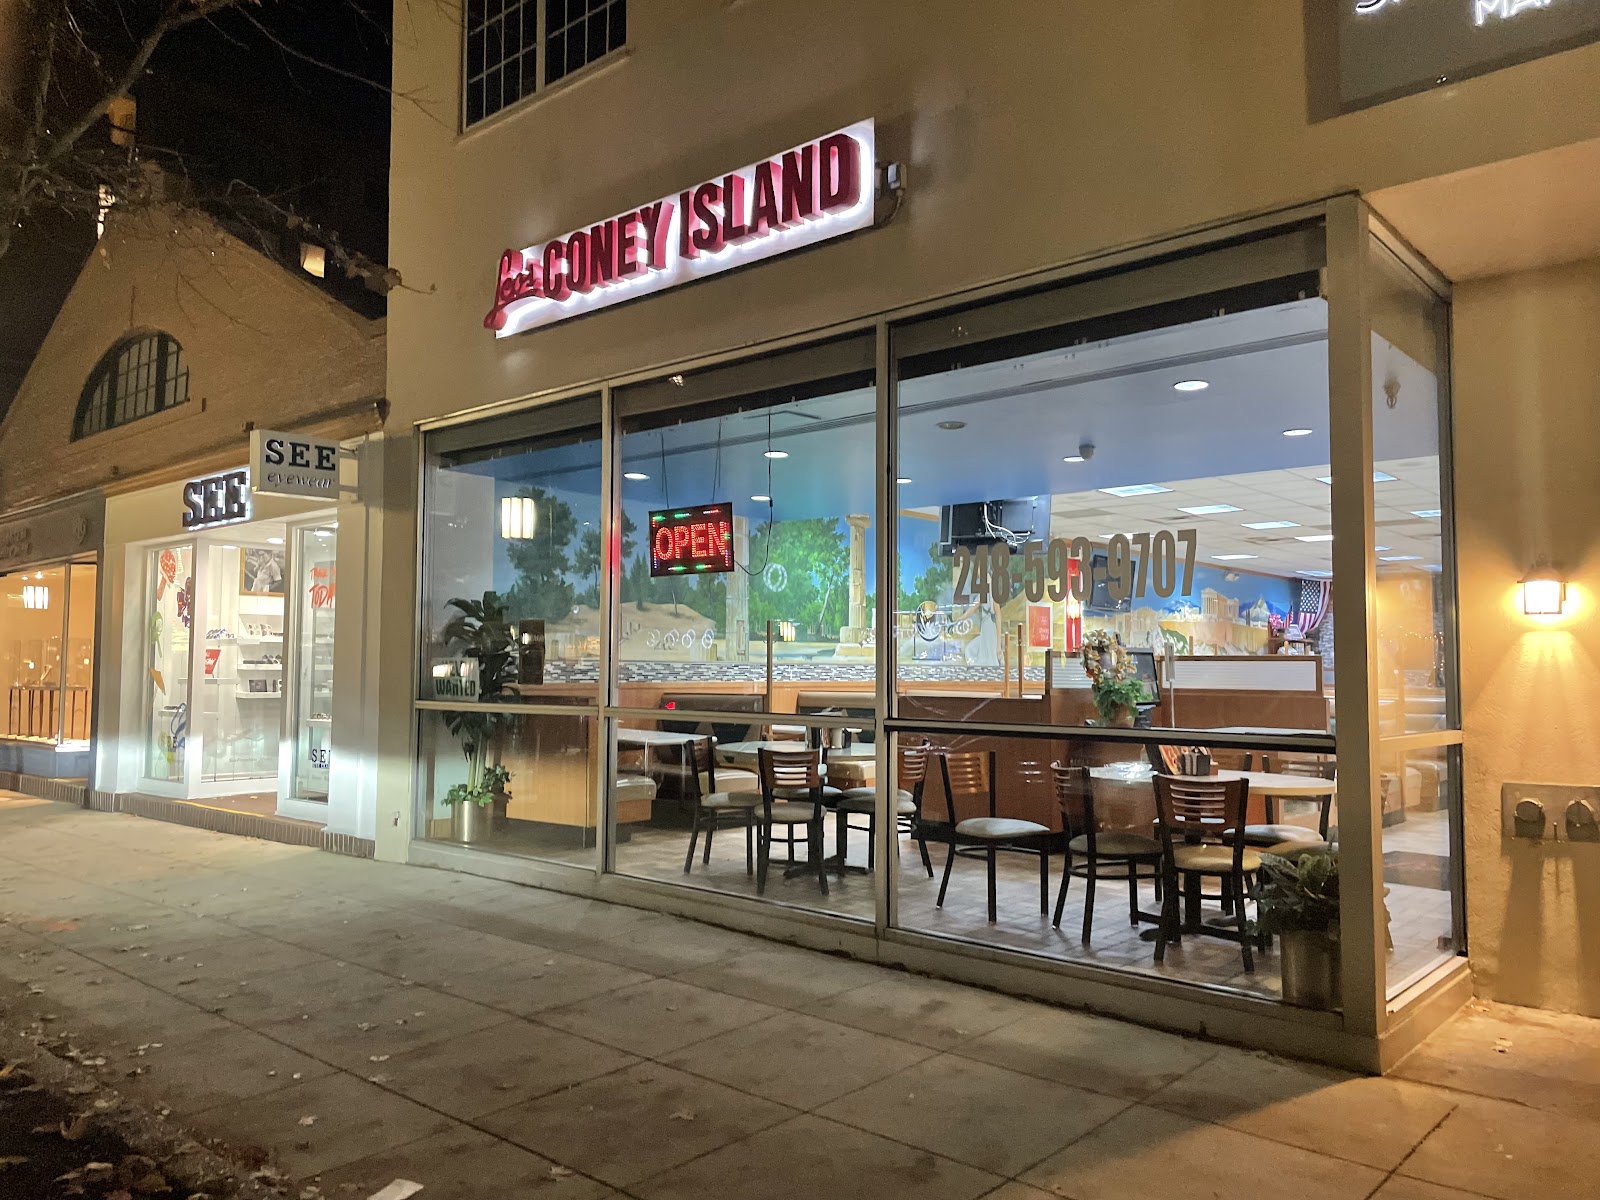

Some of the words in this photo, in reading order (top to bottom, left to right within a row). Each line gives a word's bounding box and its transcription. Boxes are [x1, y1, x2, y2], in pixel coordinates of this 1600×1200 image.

[542, 201, 674, 302] CONEY
[679, 133, 860, 260] ISLAND
[265, 438, 336, 471] SEE
[267, 471, 336, 488] eyewear
[182, 471, 248, 528] SEE
[655, 521, 729, 561] OPEN
[952, 528, 1198, 605] 248-593-9707
[435, 679, 476, 697] WANTED
[311, 748, 331, 763] SE
